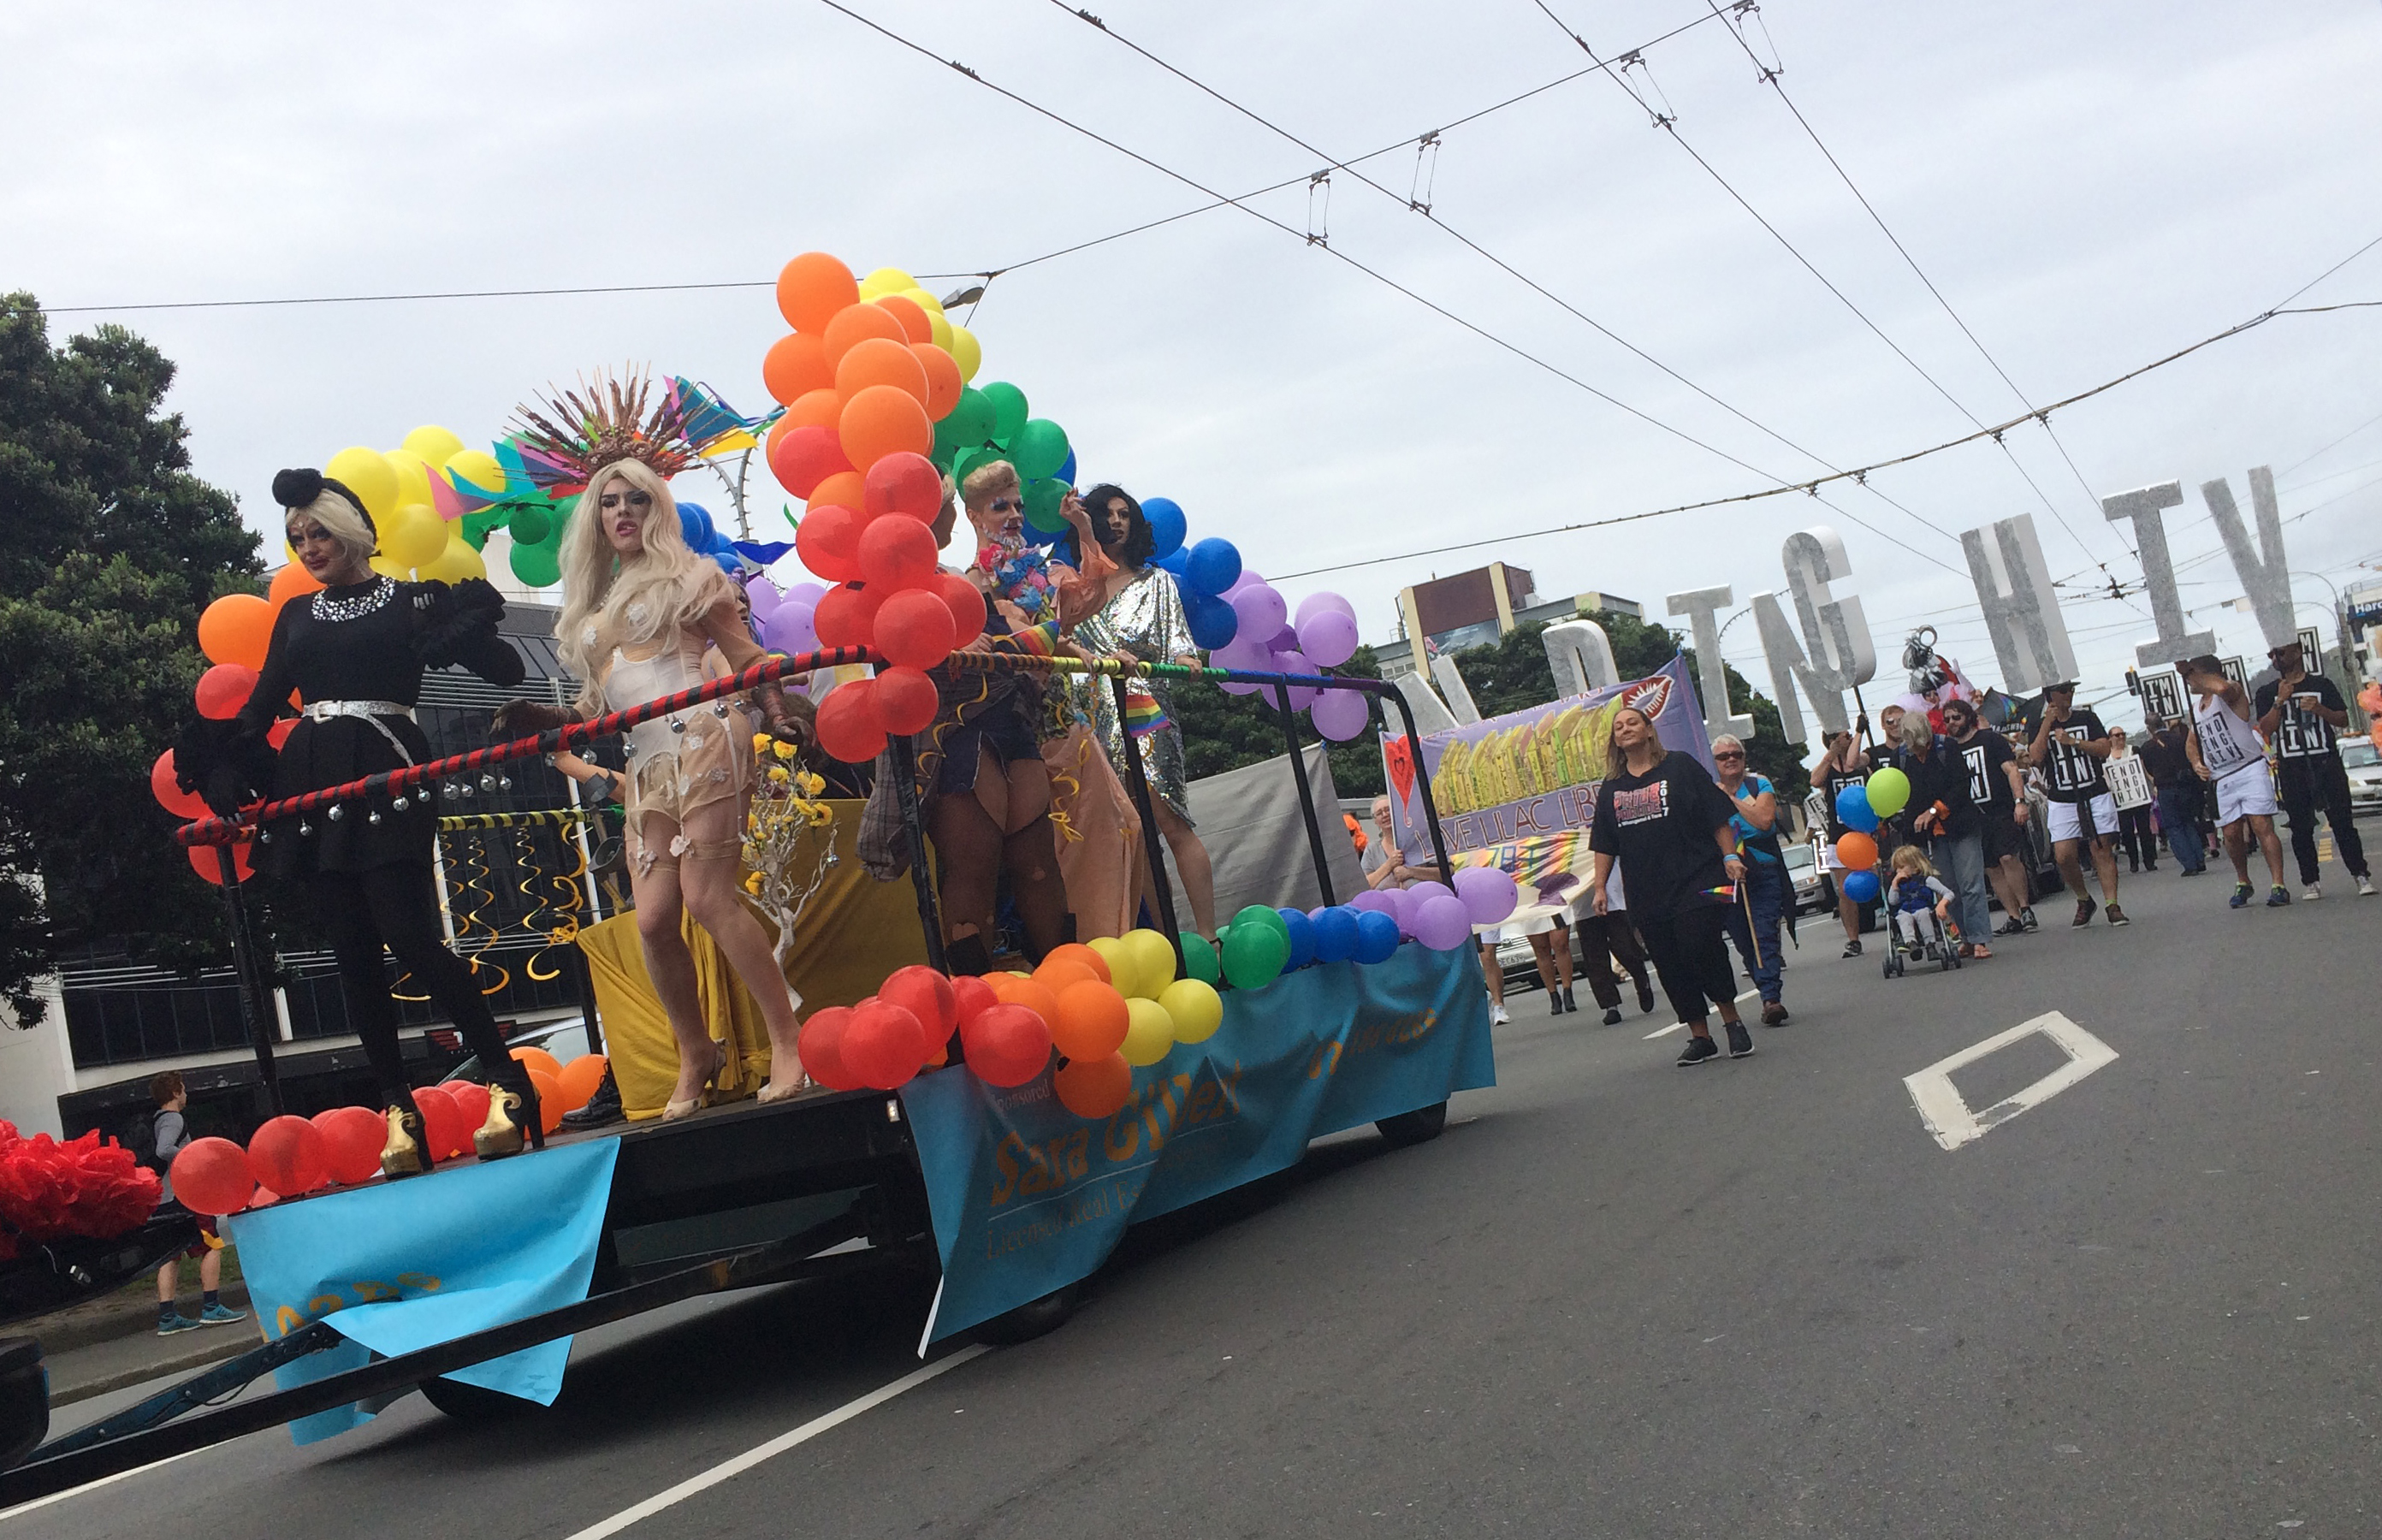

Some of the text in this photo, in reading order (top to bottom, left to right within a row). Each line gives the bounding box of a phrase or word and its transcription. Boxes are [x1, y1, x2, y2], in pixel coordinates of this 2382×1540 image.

[1959, 465, 2299, 695] HIV
[2146, 677, 2172, 699] I'M
[2199, 719, 2222, 739] END
[2285, 724, 2319, 750] IN
[2059, 756, 2089, 785] IN
[2111, 763, 2136, 780] END
[2115, 775, 2139, 791] ING
[1660, 779, 1669, 816] 2017
[2118, 786, 2142, 803] HIV
[1479, 799, 1551, 846] LILAC
[989, 1127, 1091, 1207] Sara
